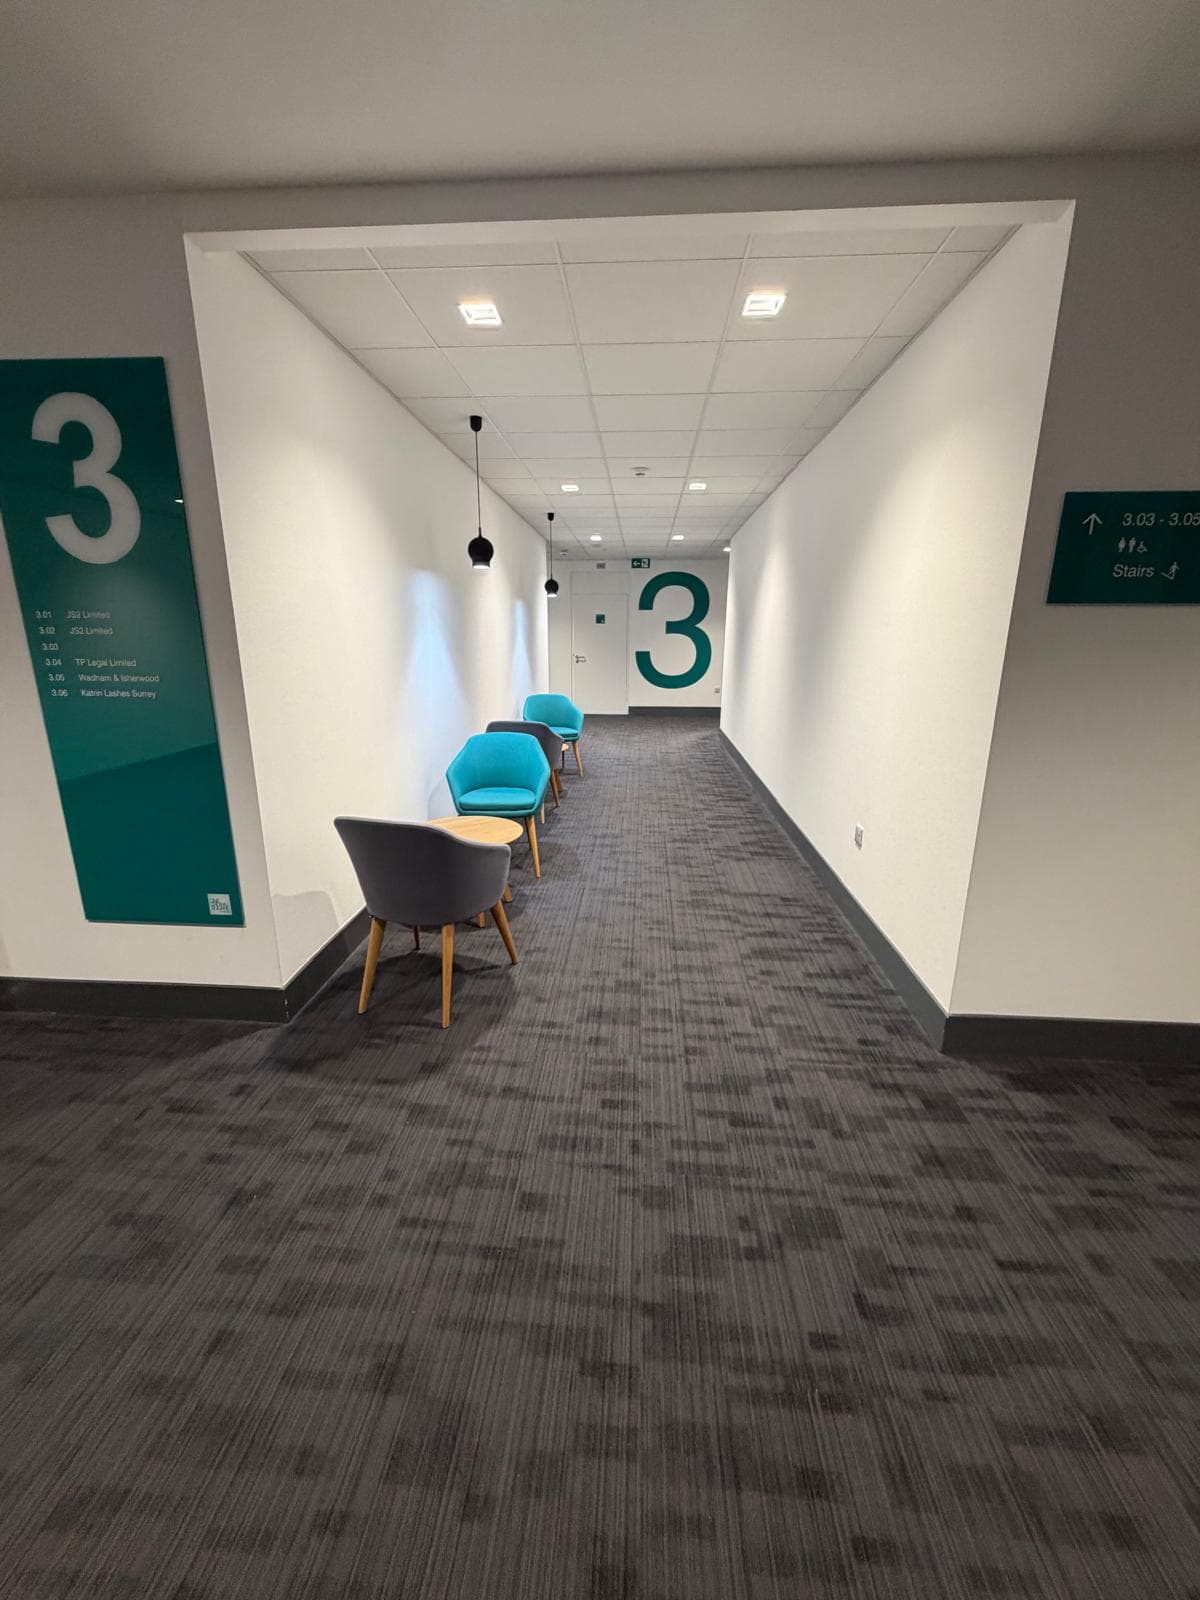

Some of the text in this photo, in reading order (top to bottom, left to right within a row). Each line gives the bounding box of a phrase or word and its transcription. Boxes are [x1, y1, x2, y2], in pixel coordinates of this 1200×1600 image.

[31, 391, 141, 565] 3
[1122, 512, 1155, 526] 3.03
[1168, 512, 1200, 526] 3.05
[1112, 563, 1155, 578] Stairs
[35, 610, 52, 619] 3.01
[82, 610, 112, 619] Limited
[39, 626, 113, 635] 3.02 JS2 Limited
[635, 571, 712, 689] 3
[42, 642, 59, 651] 3.03
[45, 658, 137, 668] 3.04 TP Legal Limited
[48, 673, 160, 682] 3.05 Wadham & Isherwood
[51, 688, 157, 699] 3.06 Katrin Lashes Surrey
